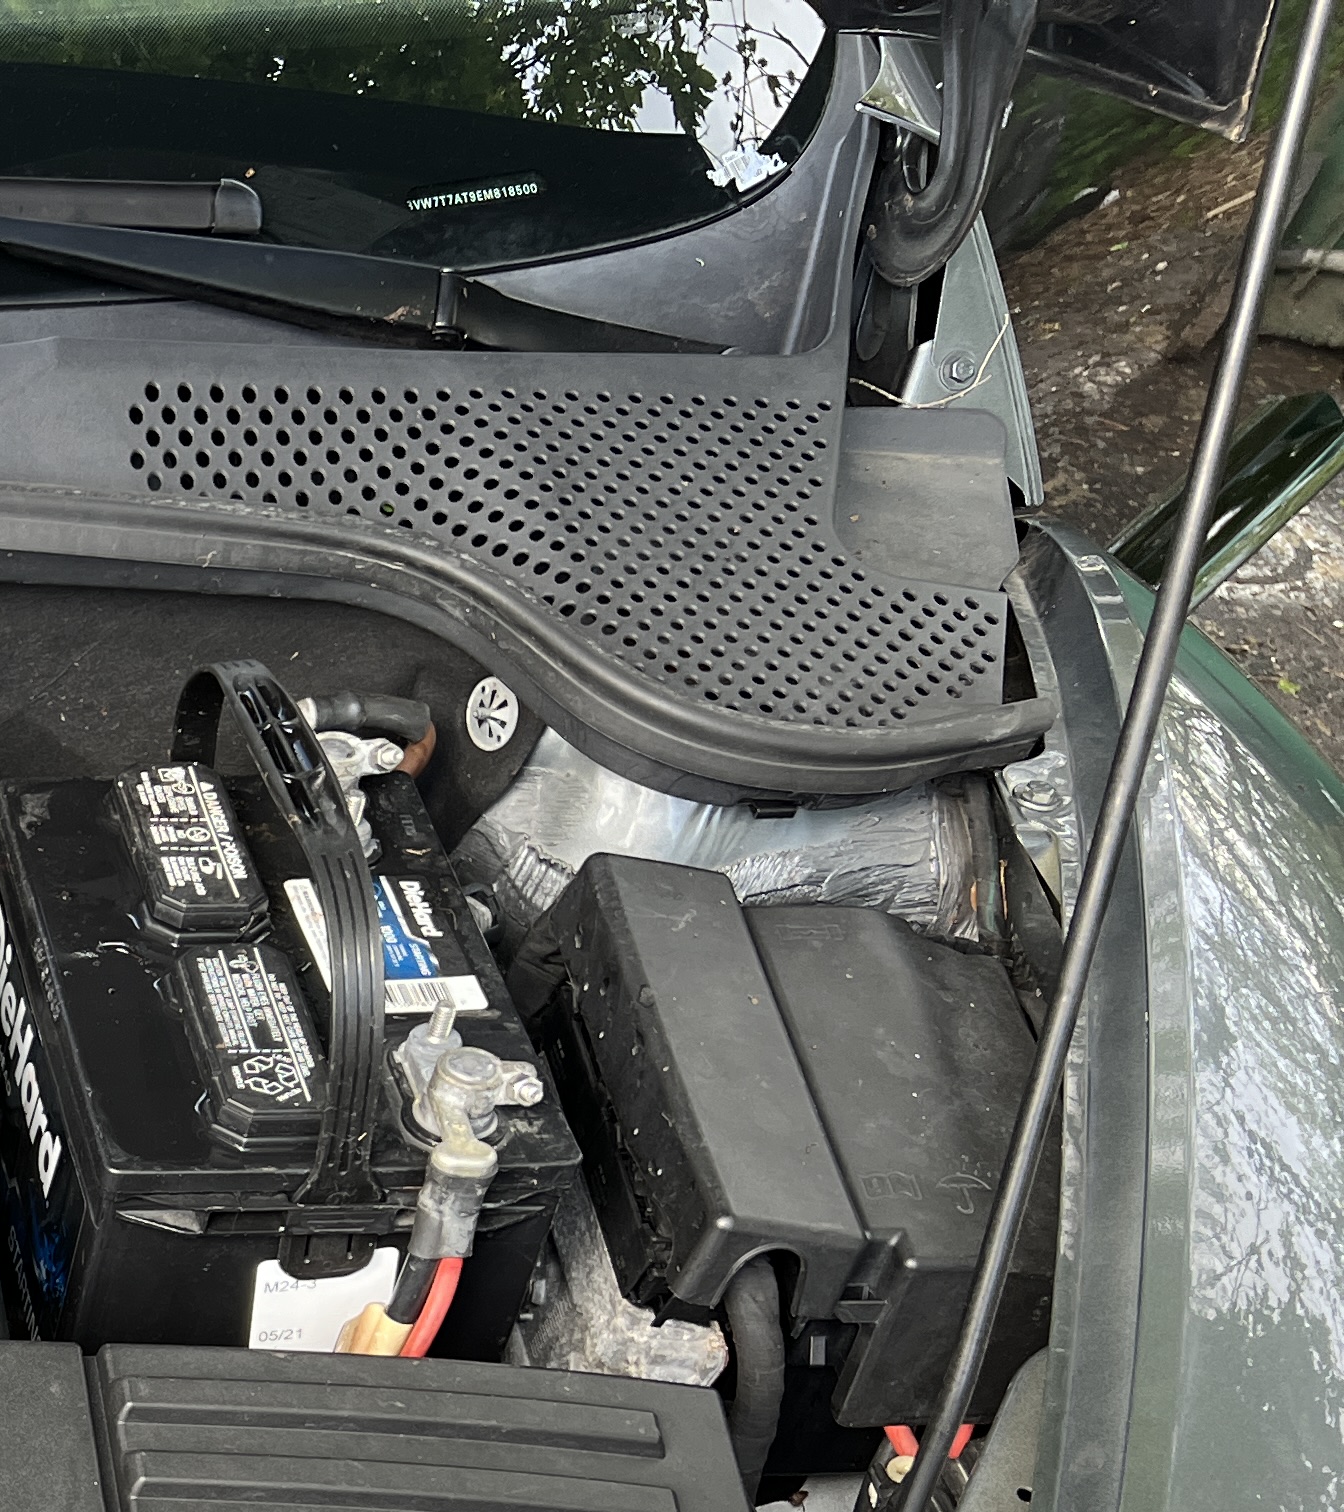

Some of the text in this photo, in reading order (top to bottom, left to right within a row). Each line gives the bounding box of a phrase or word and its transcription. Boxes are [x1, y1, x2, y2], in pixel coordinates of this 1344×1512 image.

[202, 789, 230, 834] DANGER
[222, 840, 249, 882] POISON
[398, 876, 445, 940] DieHard
[263, 1280, 317, 1294] M24-3
[258, 1329, 303, 1342] 05/21
